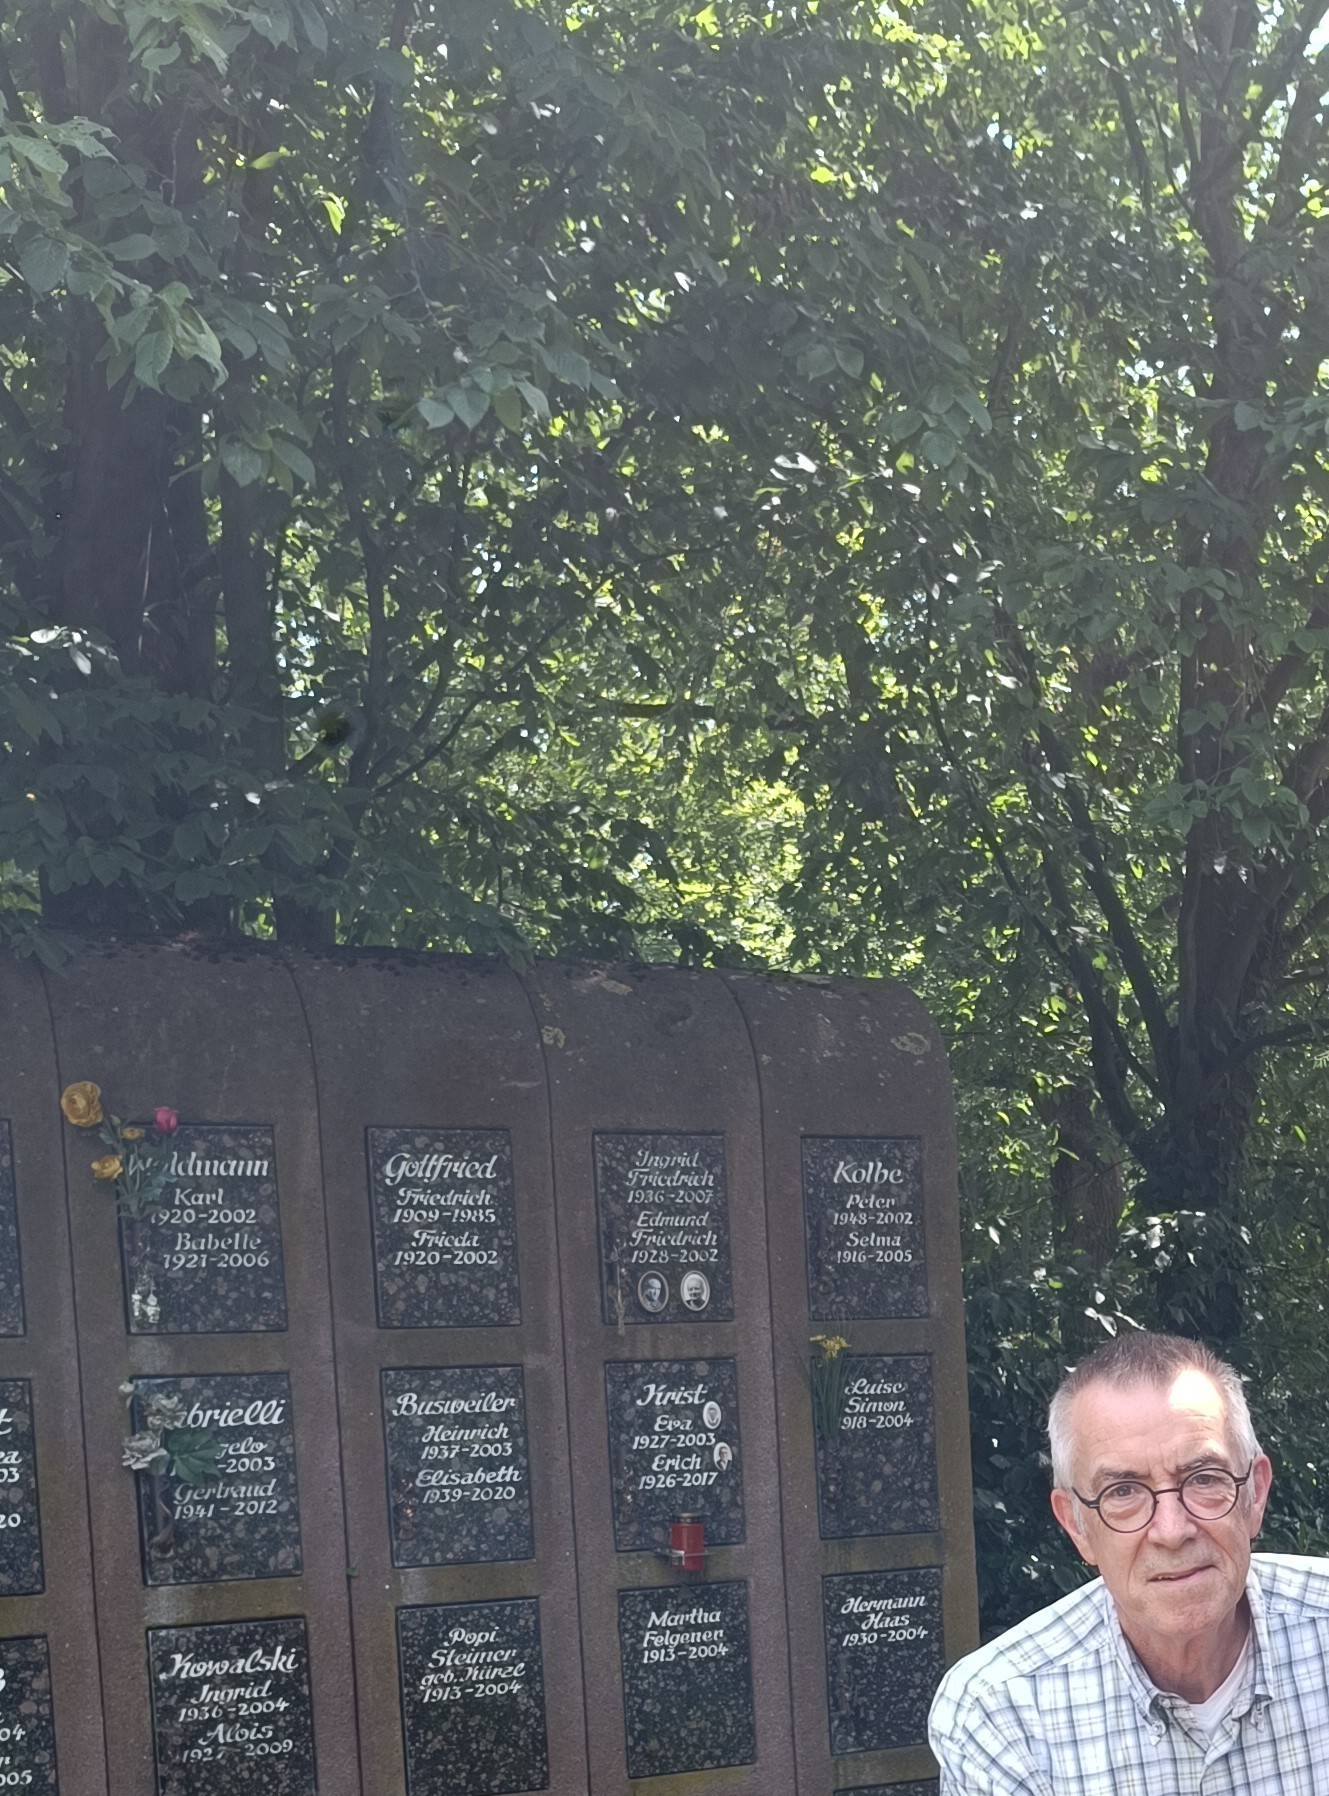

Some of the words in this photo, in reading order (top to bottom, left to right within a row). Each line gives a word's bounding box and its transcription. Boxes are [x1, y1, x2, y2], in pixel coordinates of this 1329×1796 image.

[635, 1150, 699, 1168] Ingrid
[385, 1153, 499, 1186] Gottfried
[626, 1168, 714, 1187] Friedrich
[833, 1161, 904, 1184] Kolbe
[174, 1188, 224, 1206] Karl
[397, 1187, 491, 1205] Friedrich
[627, 1189, 714, 1204] 1936-2007
[393, 1208, 496, 1223] 1909-1985
[637, 1210, 709, 1227] Edmund
[833, 1212, 913, 1225] 1948-2002
[411, 1229, 480, 1247] Frieda
[629, 1228, 717, 1247] Friedrich
[846, 1231, 901, 1246] Selma
[163, 1251, 270, 1271] 1921-2006
[394, 1250, 498, 1265] 1920-2002
[631, 1248, 718, 1263] 1928-2002
[837, 1250, 912, 1263] 1916-2005
[844, 1378, 906, 1395] Luise
[392, 1392, 516, 1416] Busweiler
[844, 1397, 907, 1413] Simon
[654, 1415, 693, 1431] Eva
[421, 1423, 509, 1442] Heinrich
[632, 1433, 716, 1449] 1927-2003
[421, 1442, 512, 1459] 1937-2003
[652, 1454, 702, 1471] Erich
[415, 1465, 522, 1487] Elisabeth
[639, 1472, 718, 1489] 1926-2017
[422, 1486, 516, 1503] 1939-2020
[841, 1596, 926, 1614] Hermann
[647, 1607, 721, 1628] Martha
[861, 1612, 910, 1630] Haas
[643, 1629, 724, 1648] Felgener
[842, 1626, 928, 1646] 1930-2004
[428, 1648, 517, 1668] Steiner
[643, 1643, 728, 1664] 1913-2004
[159, 1646, 298, 1680] Kowalski
[190, 1680, 272, 1704] Ingrid
[423, 1679, 522, 1703] 1913-2004
[198, 1723, 274, 1745] Alois
